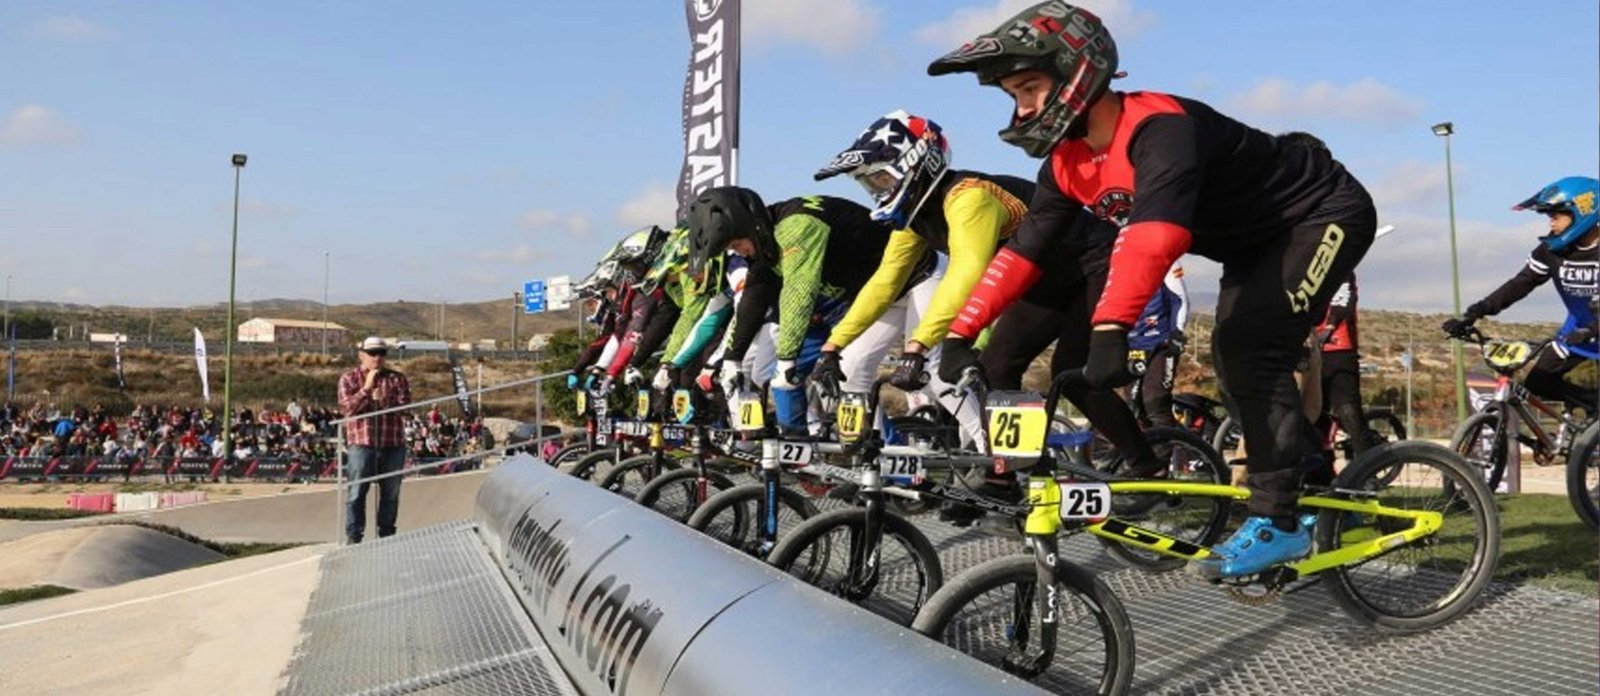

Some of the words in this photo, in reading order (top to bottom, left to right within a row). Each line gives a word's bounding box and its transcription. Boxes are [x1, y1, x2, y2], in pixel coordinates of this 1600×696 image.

[994, 412, 1021, 449] 25
[783, 444, 804, 462] 27
[887, 456, 918, 475] 728
[1067, 489, 1103, 516] 25
